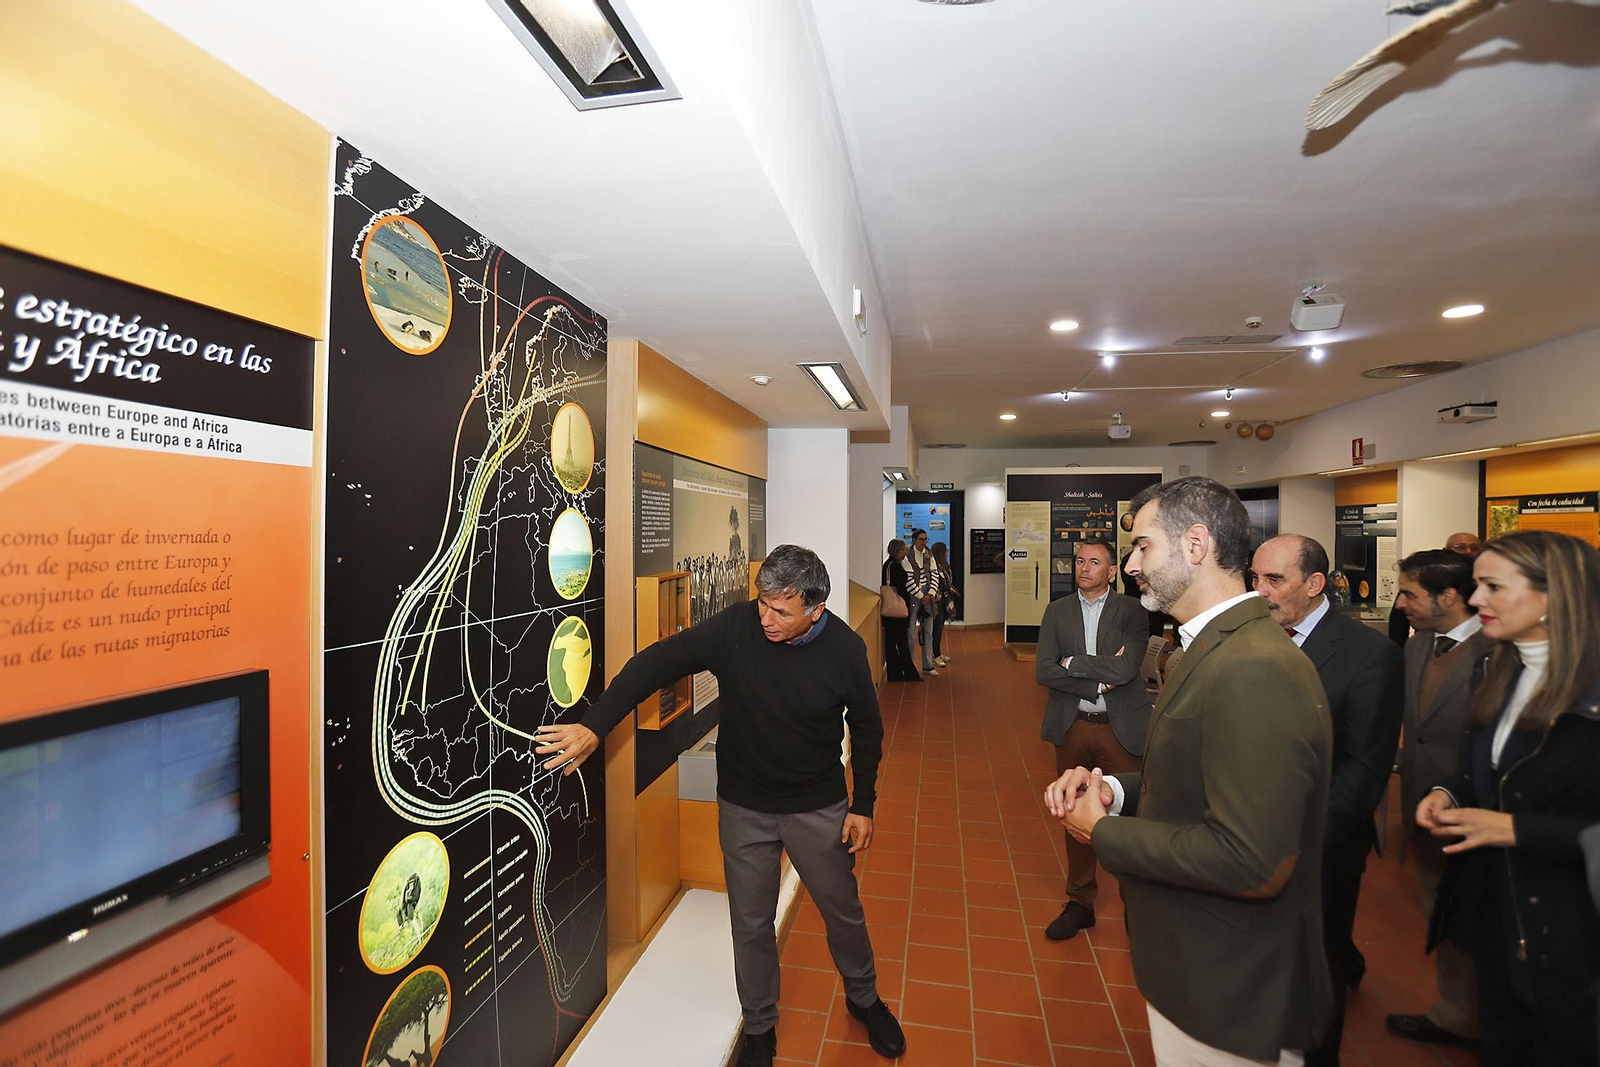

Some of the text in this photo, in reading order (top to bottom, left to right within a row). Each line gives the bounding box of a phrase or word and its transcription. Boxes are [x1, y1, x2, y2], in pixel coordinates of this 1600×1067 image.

[15, 294, 198, 357] estratégico
[203, 343, 234, 365] en
[240, 344, 273, 374] las
[7, 334, 41, 373] y
[46, 332, 162, 383] África
[27, 392, 101, 416] between
[107, 404, 159, 425] Europe
[164, 411, 188, 430] and
[192, 418, 229, 435] Africa
[68, 422, 110, 438] entre
[117, 428, 125, 440] a
[131, 428, 180, 447] Europa
[184, 438, 191, 448] e
[196, 439, 203, 449] a
[207, 434, 243, 454] África
[1537, 499, 1551, 508] fecha
[1551, 498, 1557, 506] de
[1558, 497, 1585, 505] caducidad
[1, 527, 231, 552] como lugar de invernada o
[37, 555, 59, 575] de
[66, 560, 110, 580] paso
[116, 557, 158, 572] entre
[165, 554, 219, 576] Europa
[221, 556, 231, 572] y
[0, 574, 232, 612] conjunto de humedales del
[63, 617, 81, 631] es
[89, 615, 114, 628] un
[120, 604, 161, 624] nudo
[166, 598, 232, 626] principal
[30, 643, 53, 663] de
[61, 640, 87, 659] las
[93, 636, 140, 655] rutas
[145, 625, 230, 651] migratorias
[93, 894, 128, 915] HUMAX
[105, 996, 126, 1013] aves
[170, 965, 180, 976] de
[183, 952, 204, 968] miles
[206, 945, 216, 956] de
[113, 1009, 127, 1022] las
[131, 998, 147, 1014] que
[151, 991, 160, 1001] se
[164, 970, 197, 993] mueven
[144, 1030, 174, 1052] vienen
[176, 1021, 186, 1033] de
[189, 1009, 206, 1023] más
[183, 1027, 197, 1040] sus
[211, 1022, 226, 1037] que
